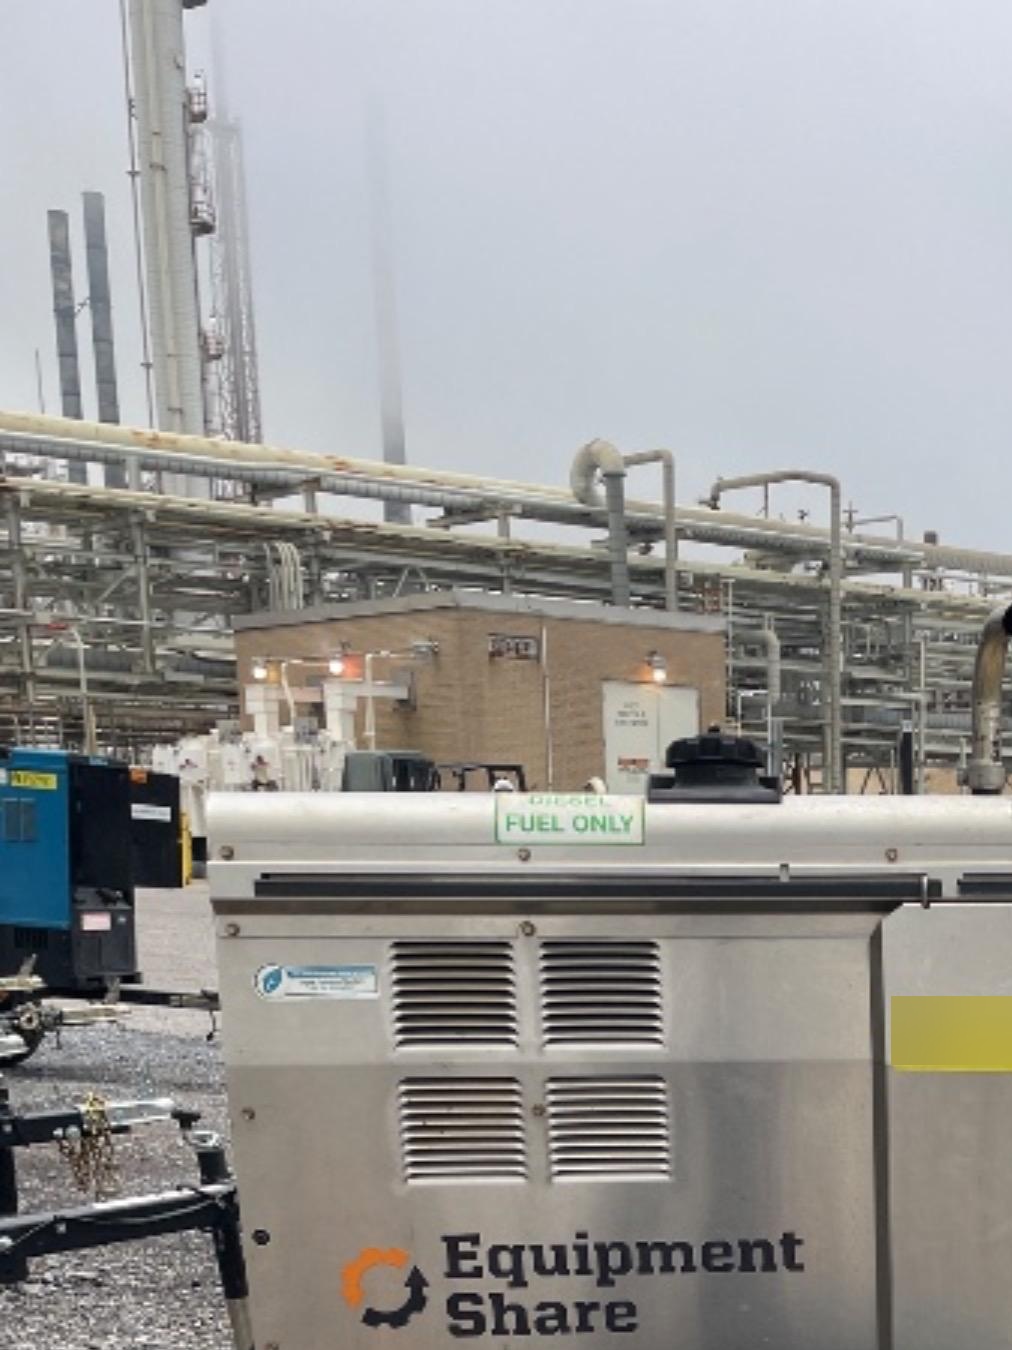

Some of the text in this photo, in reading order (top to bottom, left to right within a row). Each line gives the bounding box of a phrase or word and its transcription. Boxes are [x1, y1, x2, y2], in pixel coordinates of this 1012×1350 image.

[506, 813, 634, 833] FUEL ONLY
[441, 1229, 805, 1288] Equipment
[447, 1290, 640, 1339] Share
